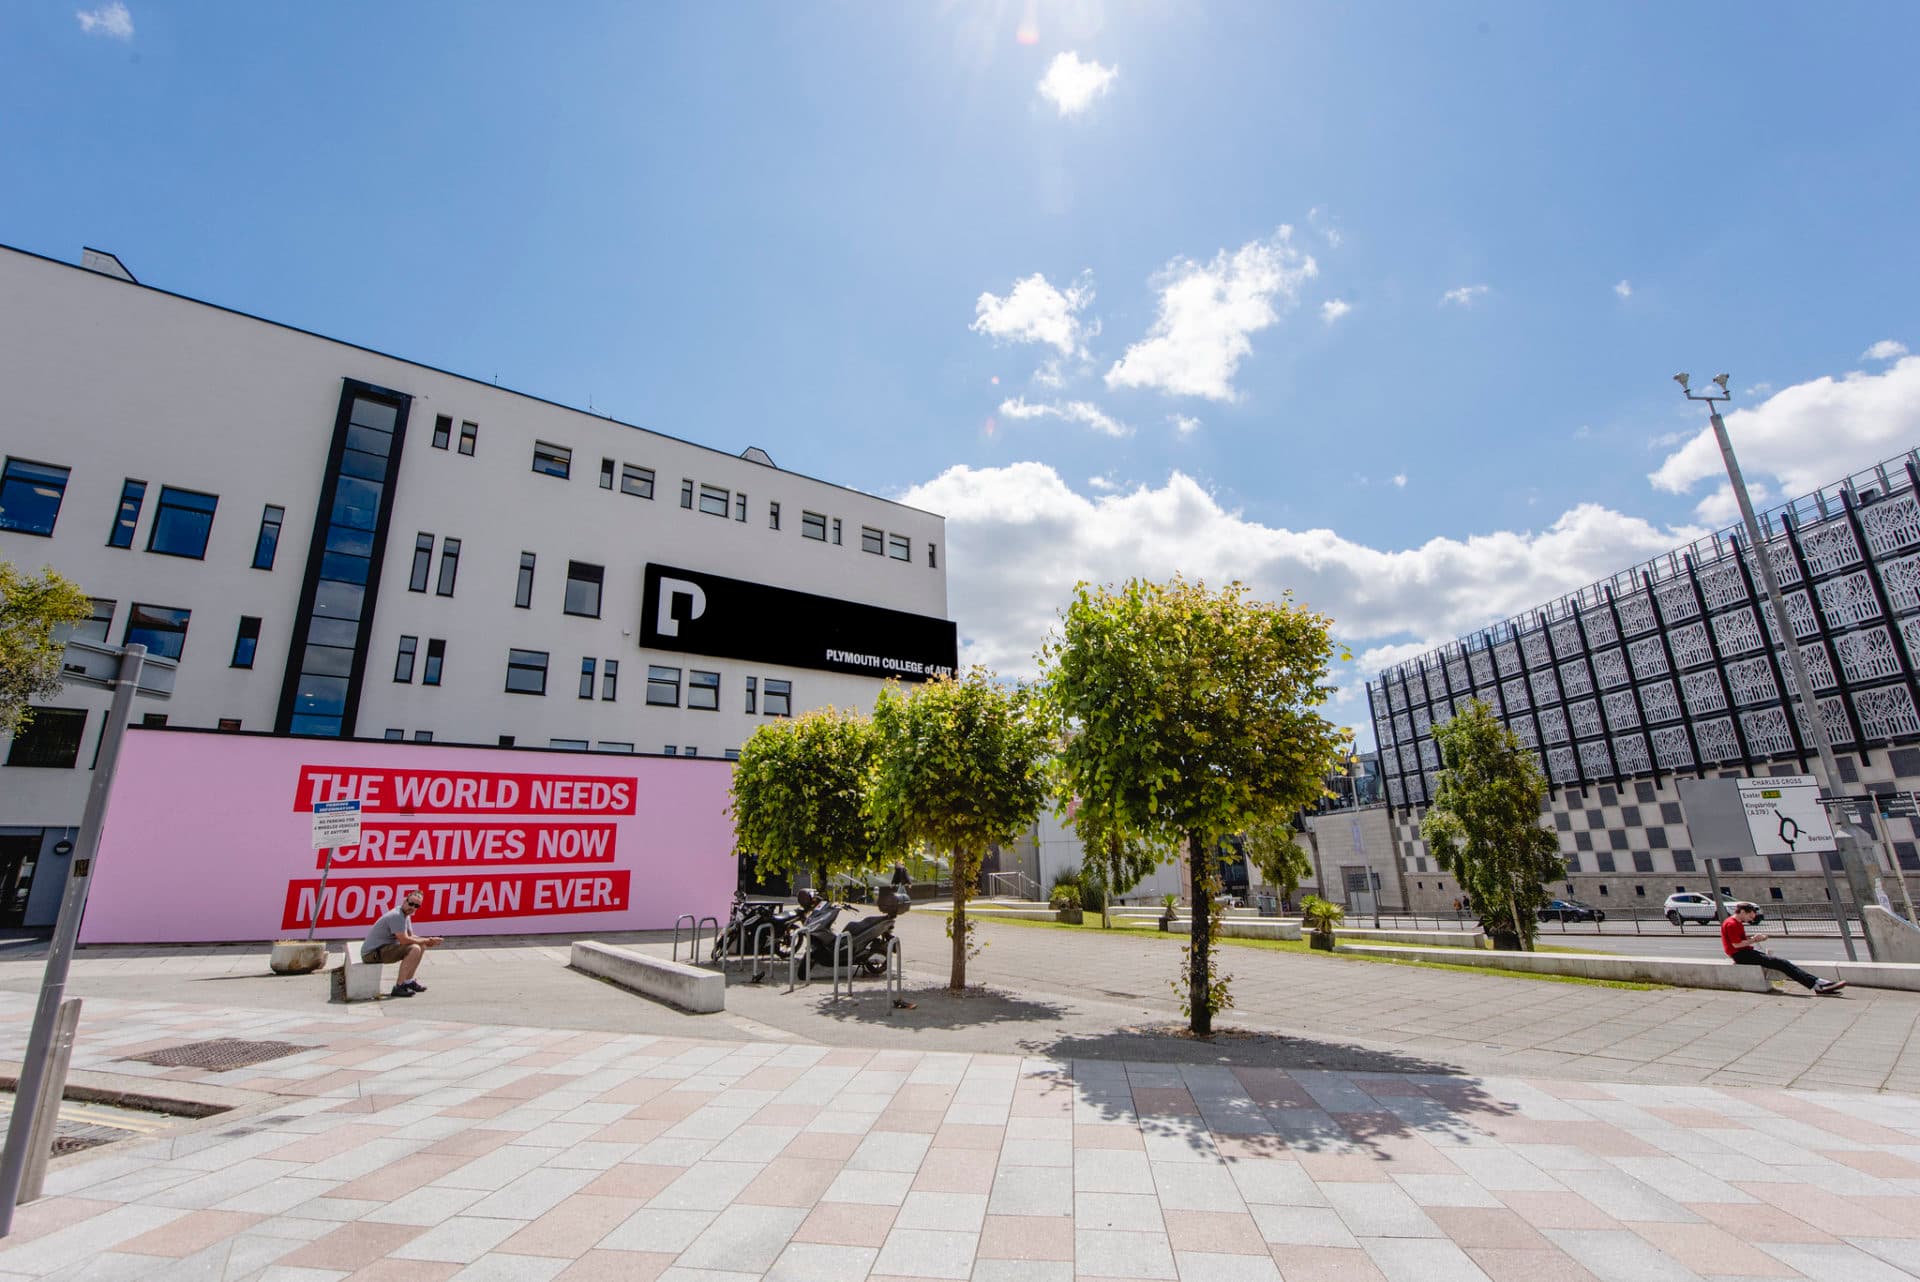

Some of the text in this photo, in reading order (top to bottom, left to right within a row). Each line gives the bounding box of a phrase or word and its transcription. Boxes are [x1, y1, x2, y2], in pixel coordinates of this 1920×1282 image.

[826, 649, 881, 668] PLYMOUTH
[882, 657, 924, 674] COLLEGE
[924, 664, 935, 675] of
[307, 773, 630, 811] THE WORLD NEEDS
[1745, 801, 1777, 809] Kingsbridge
[536, 829, 610, 858] NOW
[295, 877, 620, 922] MORE THAN EVER.
